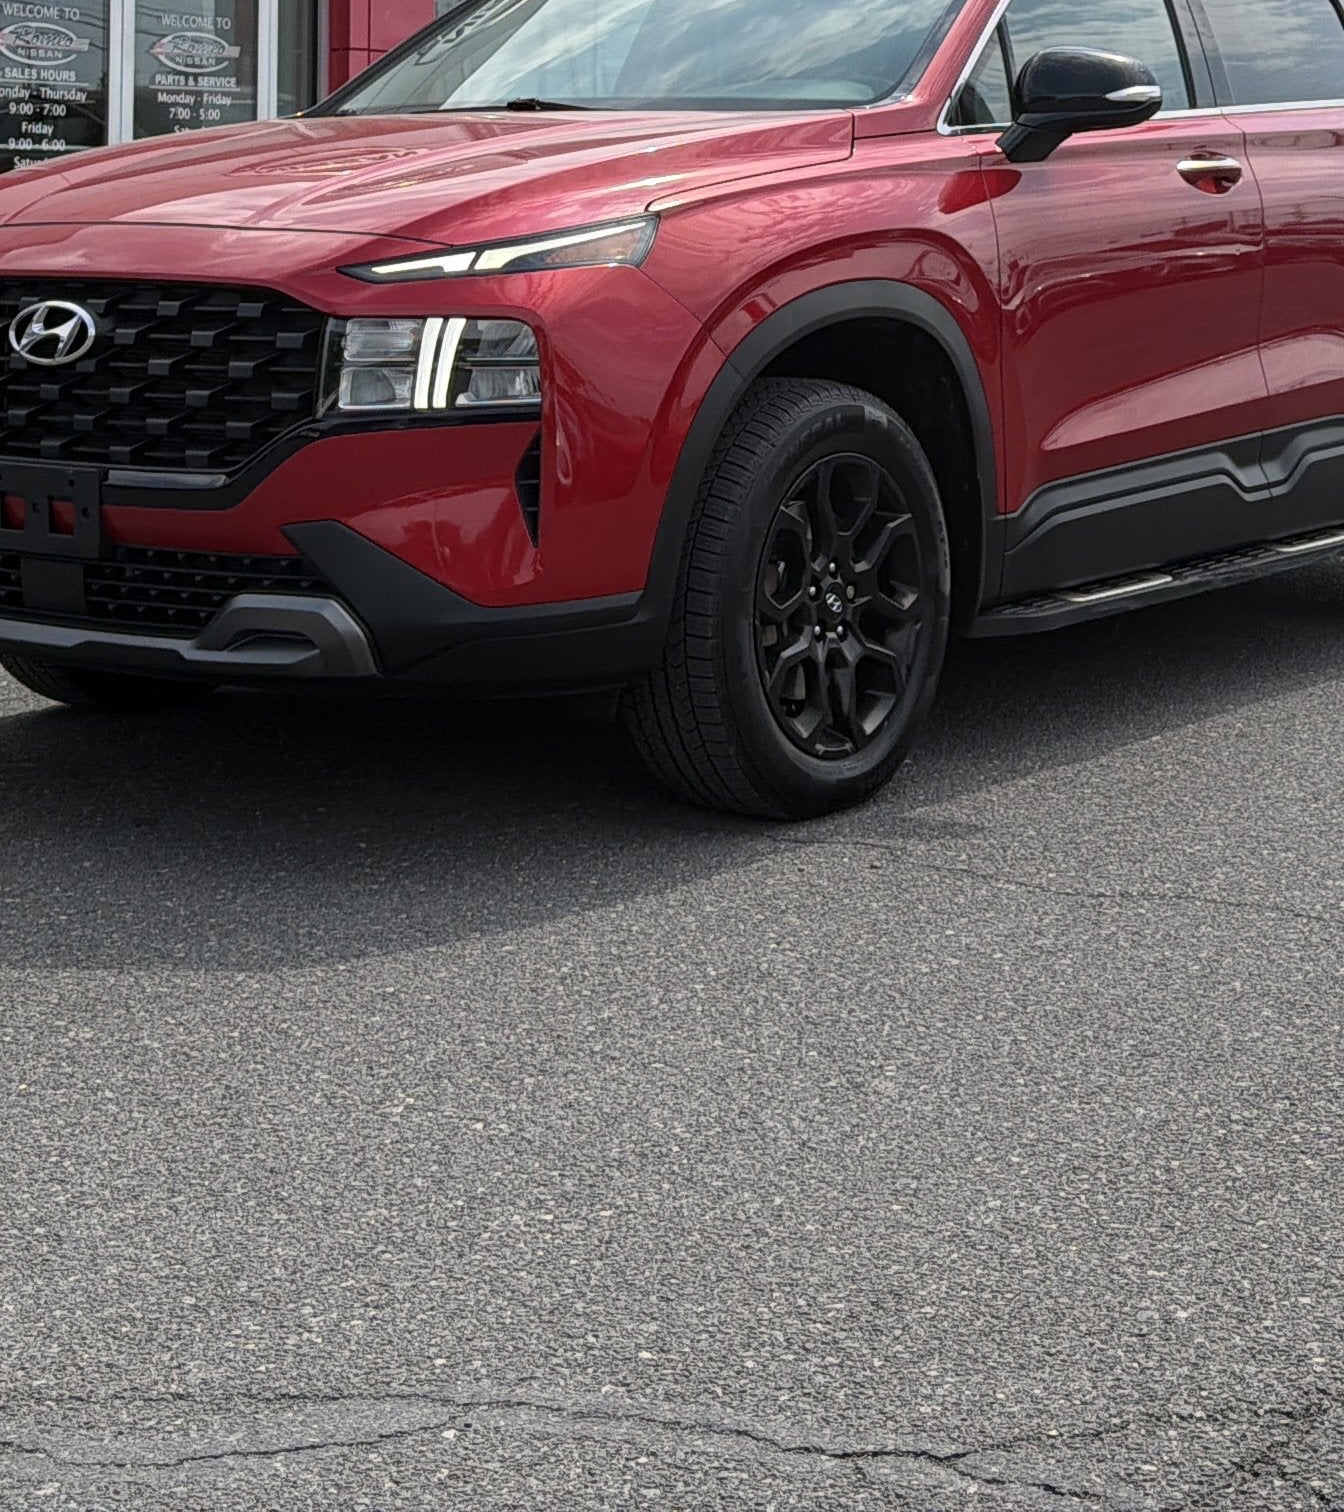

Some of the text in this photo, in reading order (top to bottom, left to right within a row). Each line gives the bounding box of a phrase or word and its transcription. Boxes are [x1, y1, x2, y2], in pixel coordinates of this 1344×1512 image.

[2, 2, 80, 21] WELCOME TO
[161, 14, 232, 30] WELCOME TO
[17, 48, 63, 59] NISSAN
[176, 56, 216, 66] NISSAN
[4, 67, 76, 82] SALES HOURS
[155, 74, 237, 88] PARTS & SERVICE
[40, 86, 87, 103] Thursday
[157, 92, 196, 106] Monday
[203, 93, 232, 106] Friday
[9, 102, 33, 116] 9:00
[43, 103, 67, 117] 7:00
[169, 108, 191, 120] 7:00
[199, 109, 221, 121] 5:00
[21, 121, 54, 137] Friday
[8, 138, 33, 150] 9:00
[42, 139, 66, 151] 6:00
